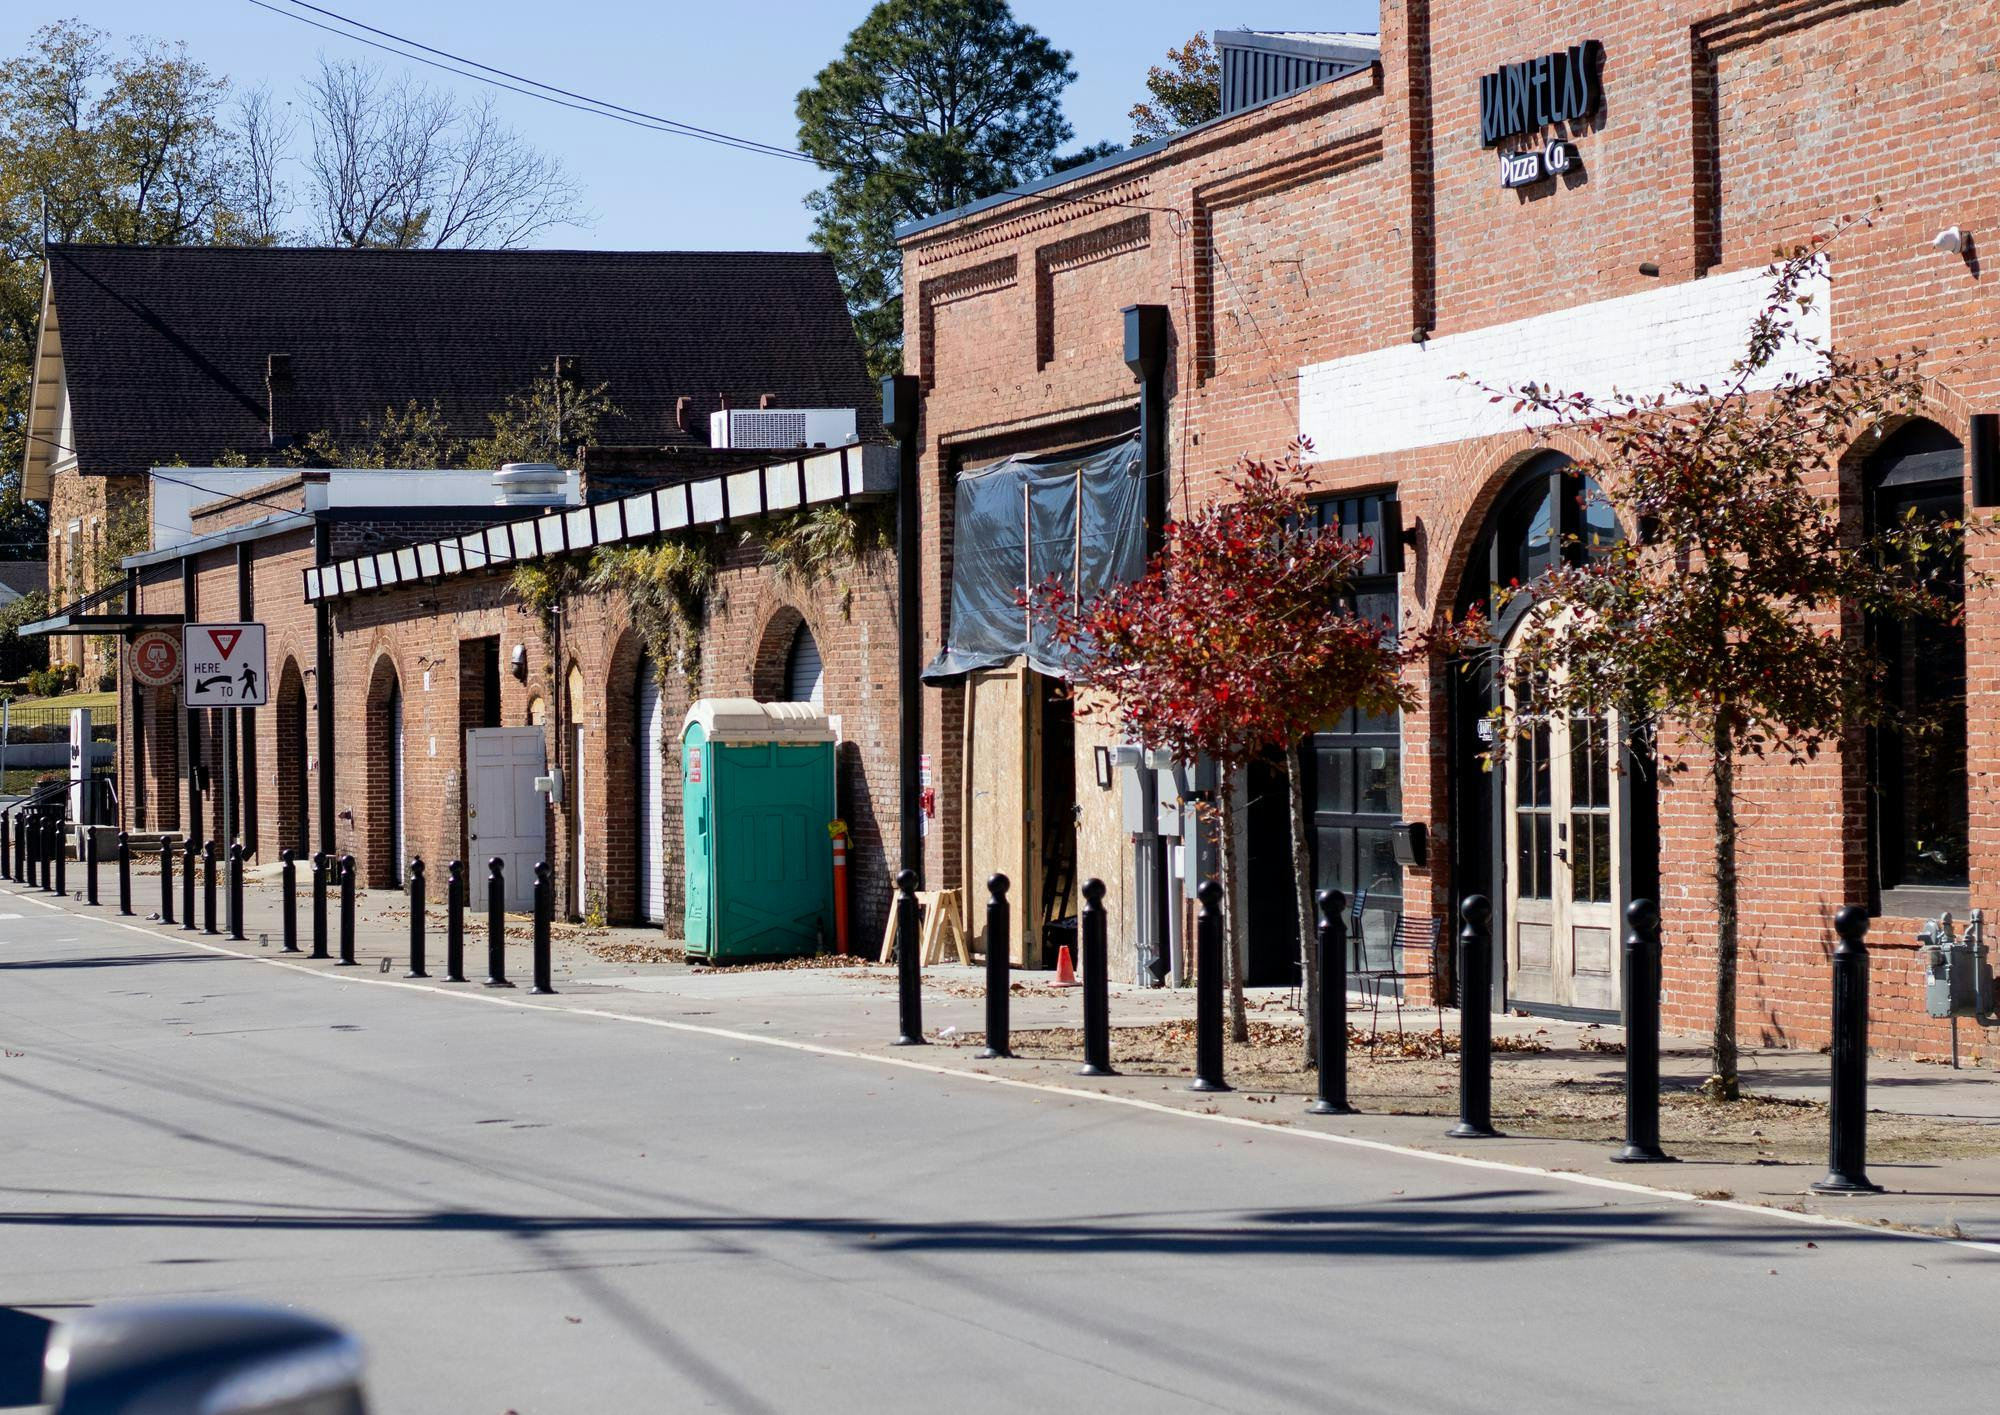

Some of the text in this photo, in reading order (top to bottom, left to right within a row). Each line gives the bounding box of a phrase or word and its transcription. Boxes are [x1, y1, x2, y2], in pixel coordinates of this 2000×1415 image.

[1480, 40, 1590, 149] KARVELAS
[1501, 141, 1569, 185] Pizza Co.
[194, 663, 221, 673] HERE
[221, 686, 233, 697] TO
